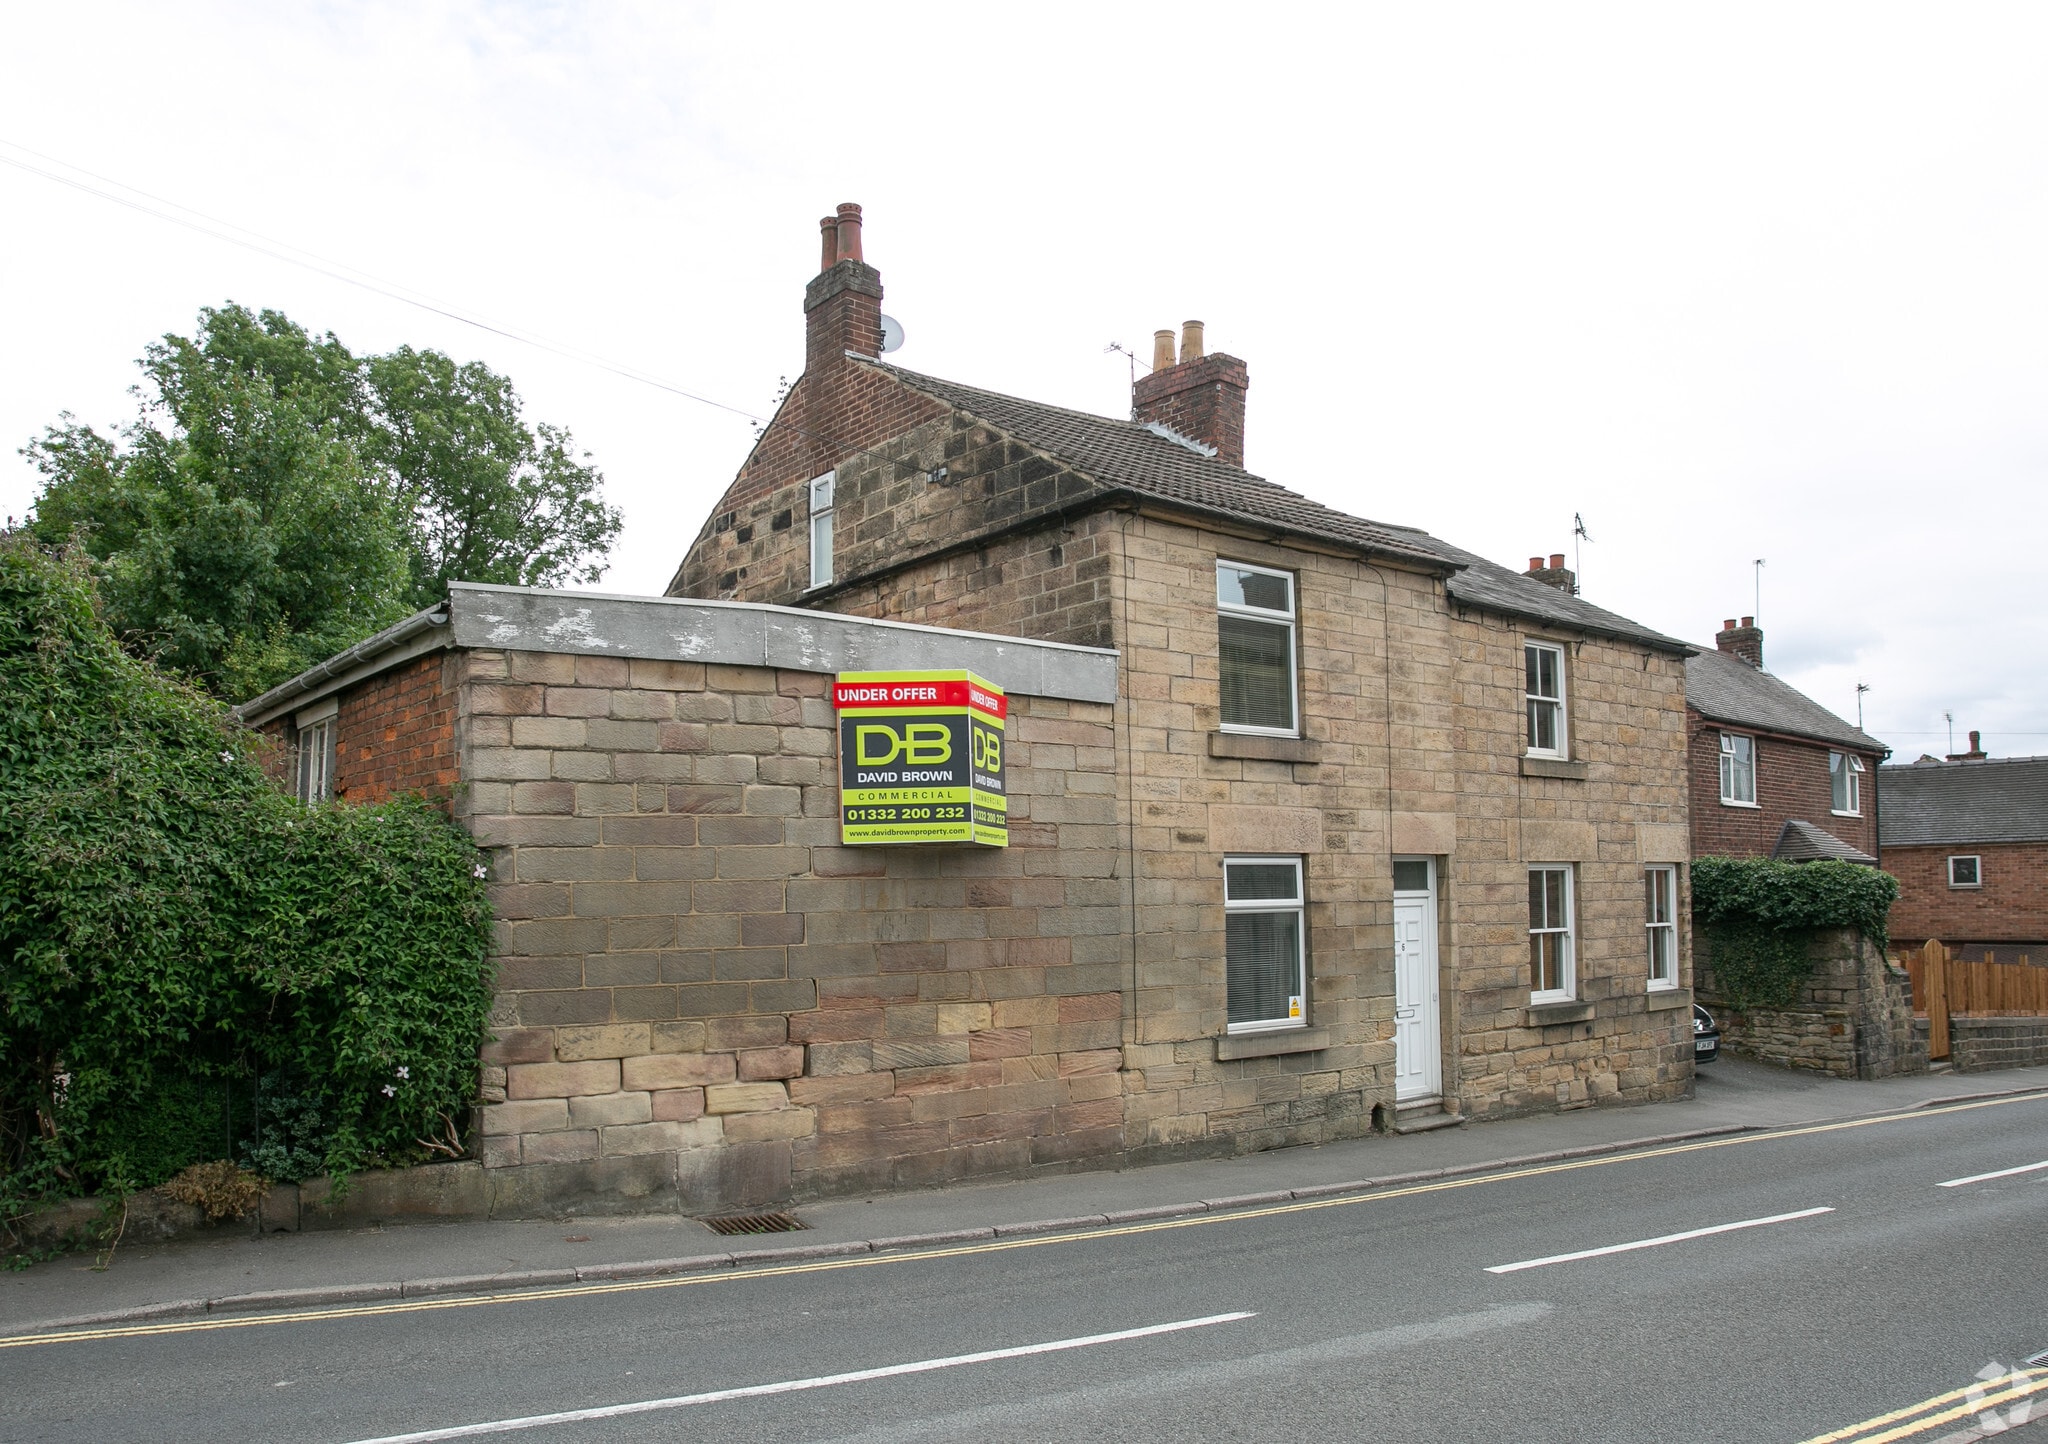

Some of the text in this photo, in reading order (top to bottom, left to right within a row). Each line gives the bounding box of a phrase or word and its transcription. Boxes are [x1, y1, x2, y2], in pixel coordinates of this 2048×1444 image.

[838, 687, 937, 702] UNDER OFFER
[971, 689, 999, 712] UNDER OFFER
[856, 723, 952, 766] DB
[974, 726, 1000, 773] DB
[857, 770, 953, 783] DAVID BROWN
[975, 773, 1002, 790] DAVID BROWN
[858, 791, 953, 801] COMMERCIAL
[975, 793, 1002, 807] COMMERCIAL
[847, 807, 965, 821] 01332 200 232
[973, 808, 1006, 825] 01332 200 232
[849, 827, 965, 838] www.davidbrownproperty.com
